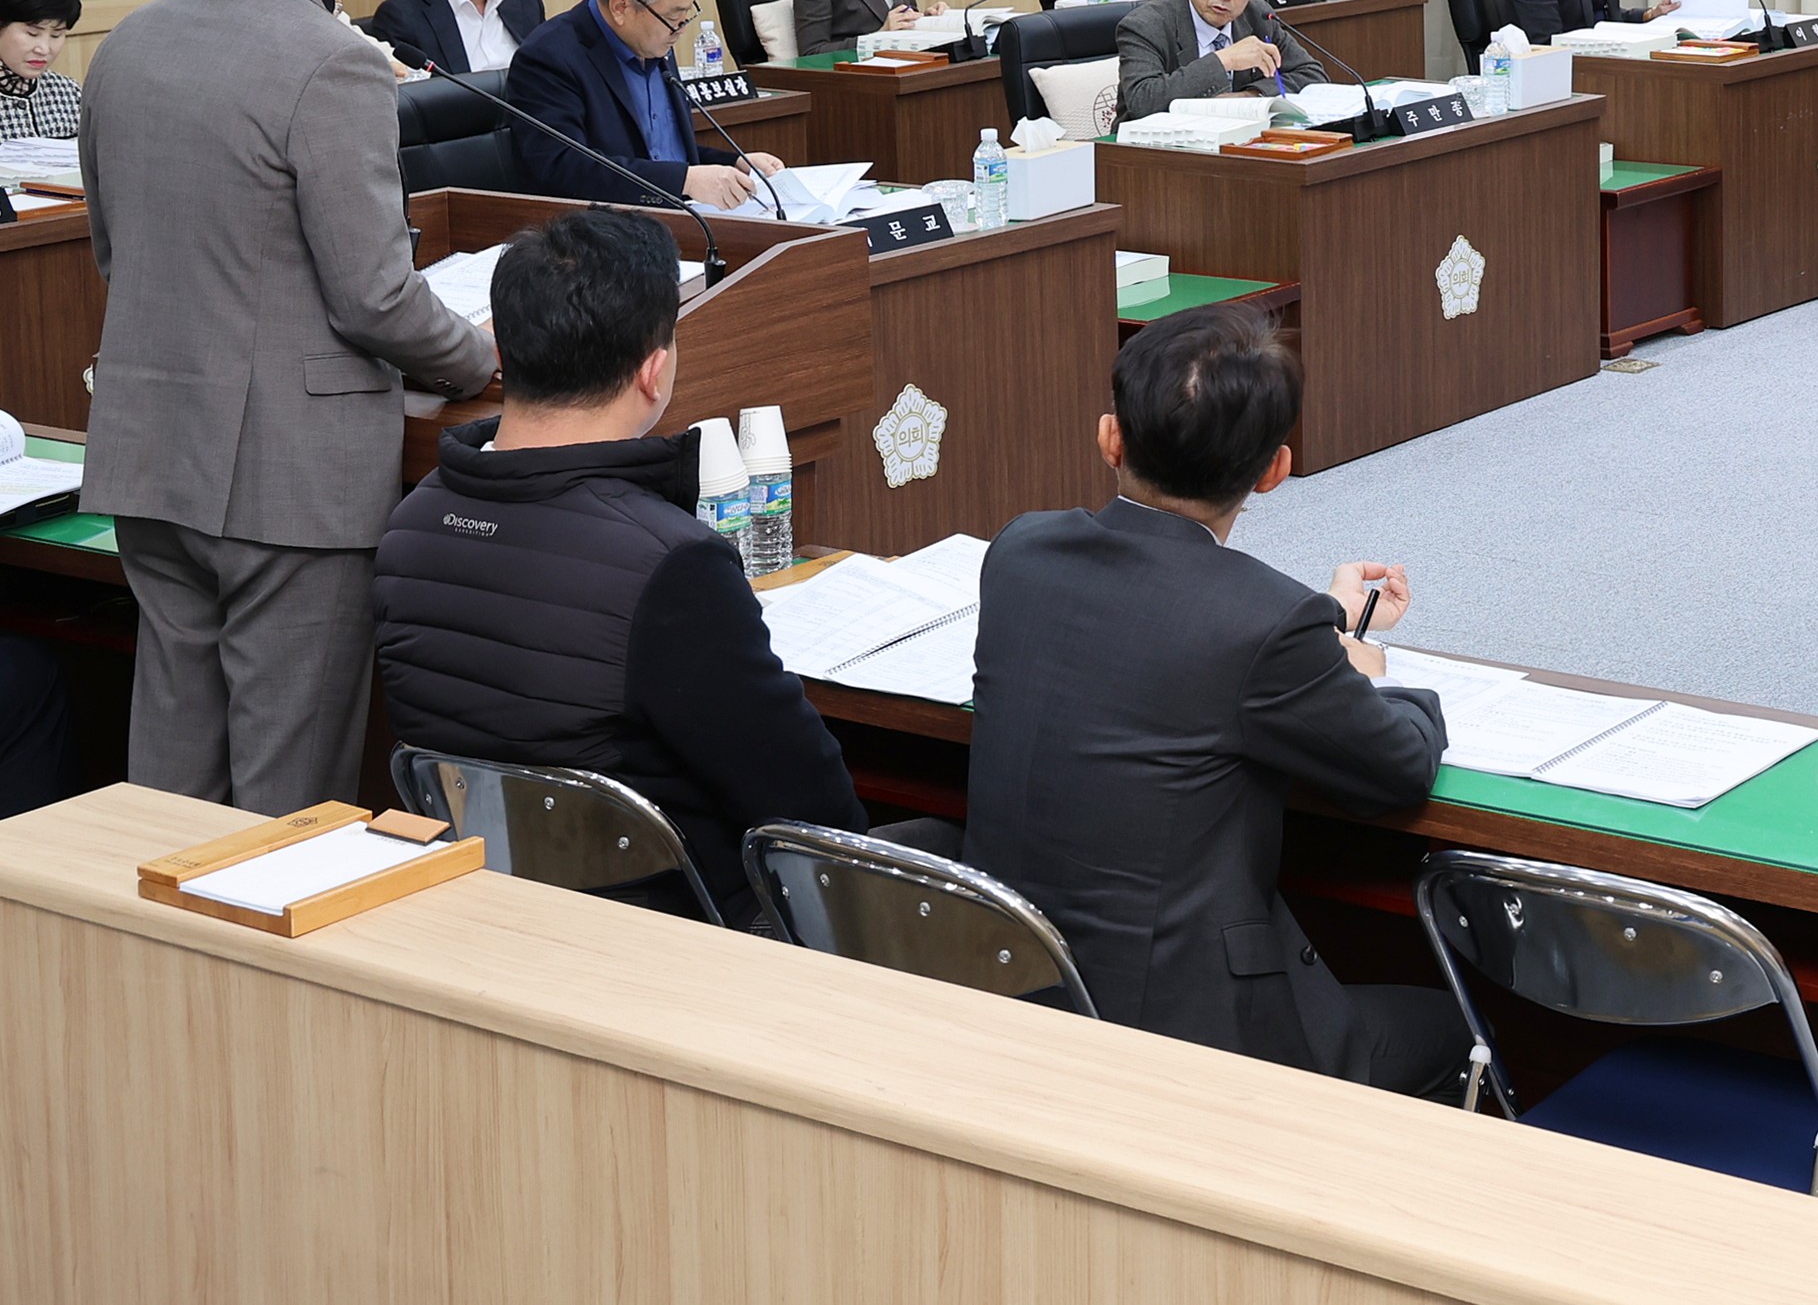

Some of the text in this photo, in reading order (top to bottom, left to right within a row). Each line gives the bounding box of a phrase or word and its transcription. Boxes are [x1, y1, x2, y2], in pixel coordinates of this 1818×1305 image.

[1405, 99, 1464, 128] 주만종
[866, 214, 941, 249] 문교
[897, 423, 926, 448] 의회
